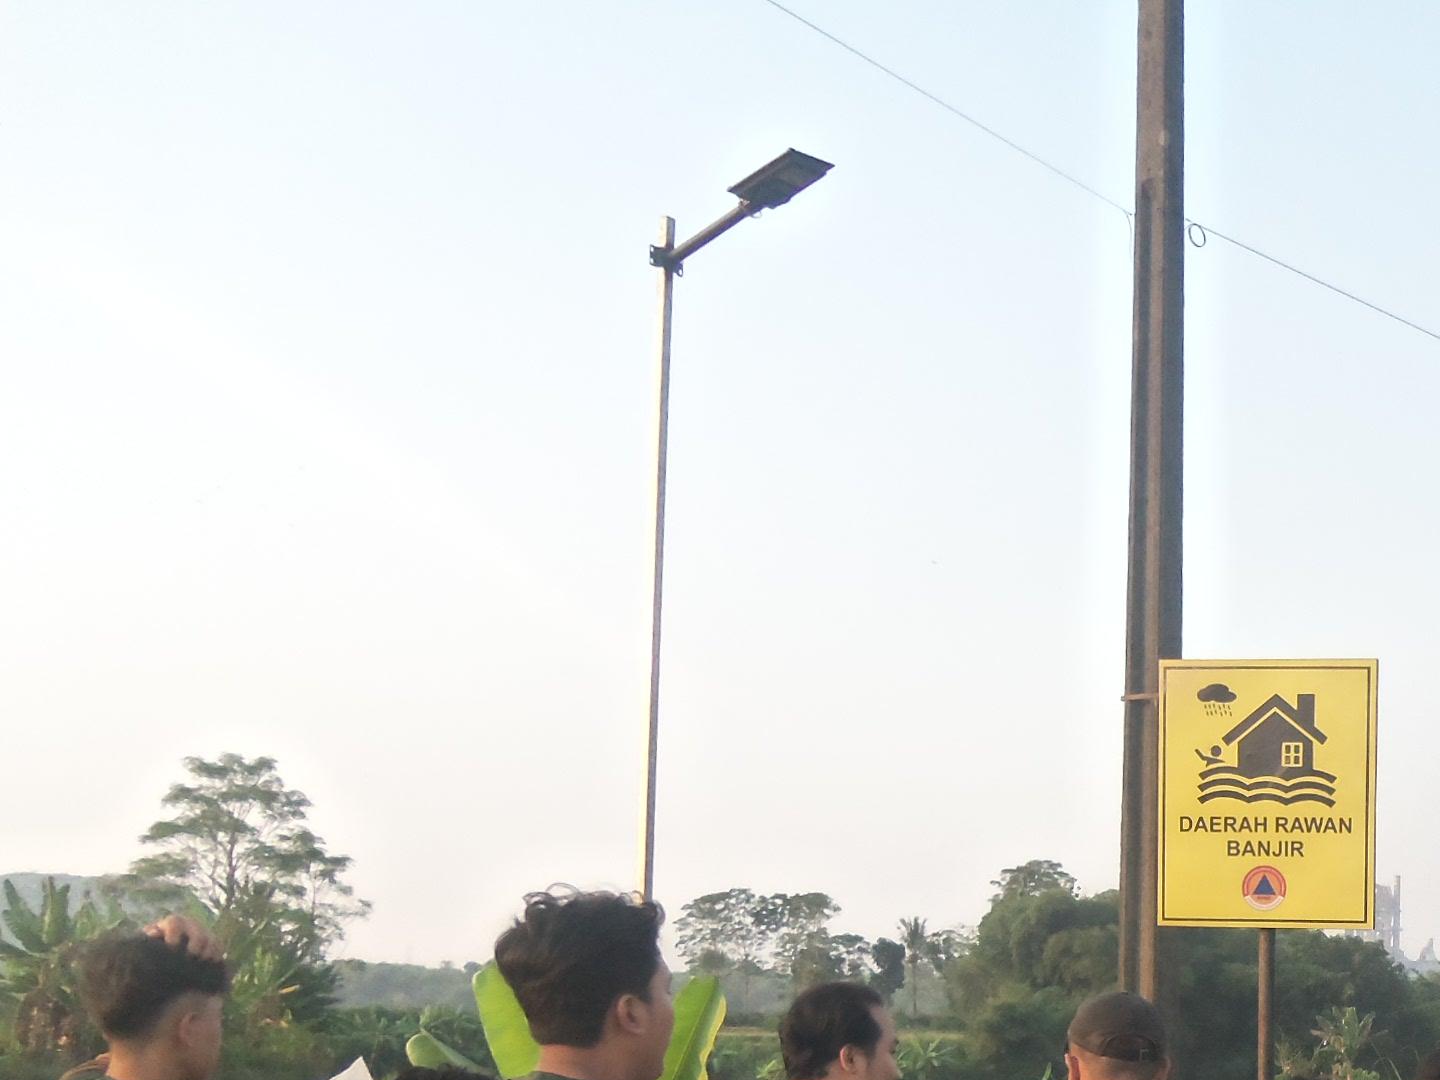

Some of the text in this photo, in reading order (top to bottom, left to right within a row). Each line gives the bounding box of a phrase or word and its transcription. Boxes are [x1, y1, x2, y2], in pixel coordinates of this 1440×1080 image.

[1179, 816, 1352, 834] DAERAH RAWAN
[1226, 840, 1305, 857] BANJIR
